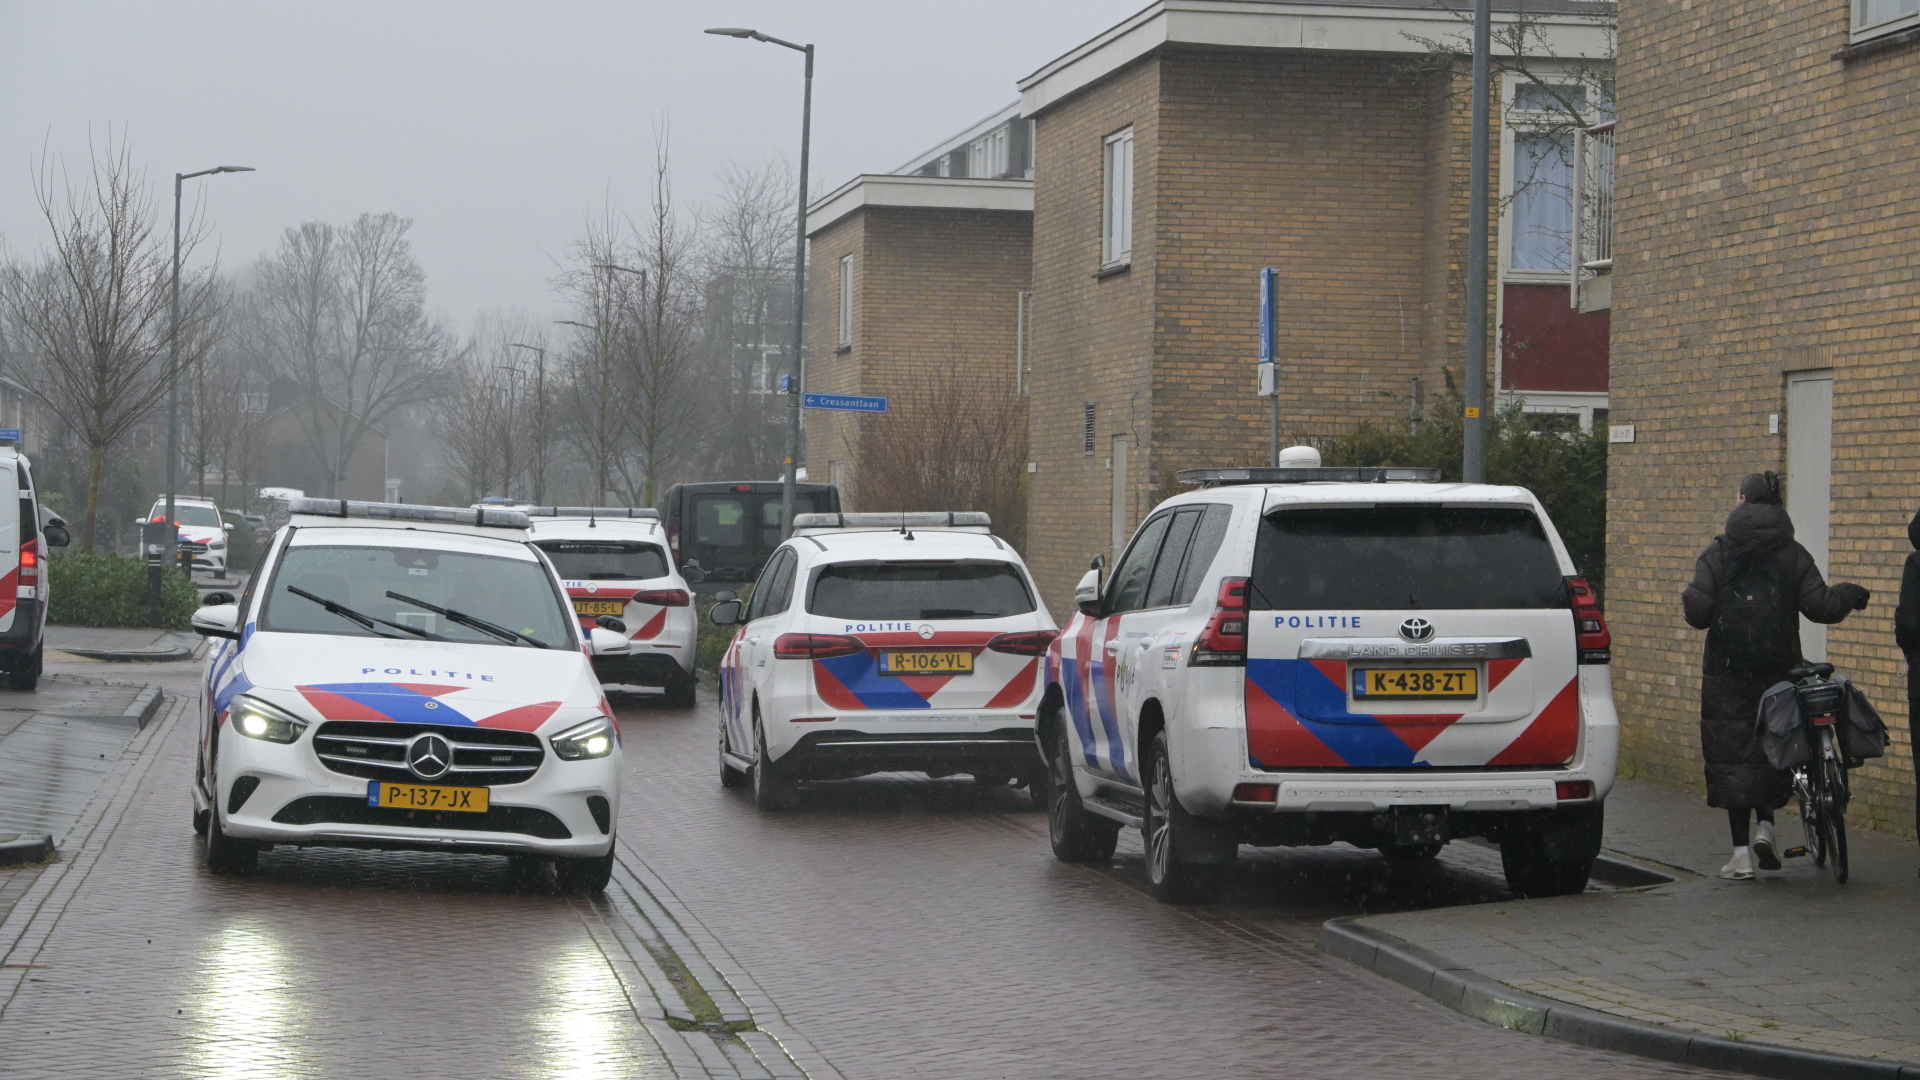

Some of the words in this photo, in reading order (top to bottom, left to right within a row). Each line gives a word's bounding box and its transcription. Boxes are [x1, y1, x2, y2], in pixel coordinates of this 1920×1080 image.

[820, 397, 879, 408] Cressantlaan
[574, 602, 618, 613] JT-85-L
[845, 622, 912, 633] POLITIE
[1274, 616, 1361, 628] POLITIE
[1348, 644, 1398, 657] LAND
[1405, 644, 1486, 657] CRUISER
[895, 654, 966, 669] R-106-VL
[361, 667, 495, 682] POLITIE
[1374, 672, 1467, 692] K-438-ZT
[369, 795, 378, 803] NL
[388, 786, 472, 808] P-137-JX
